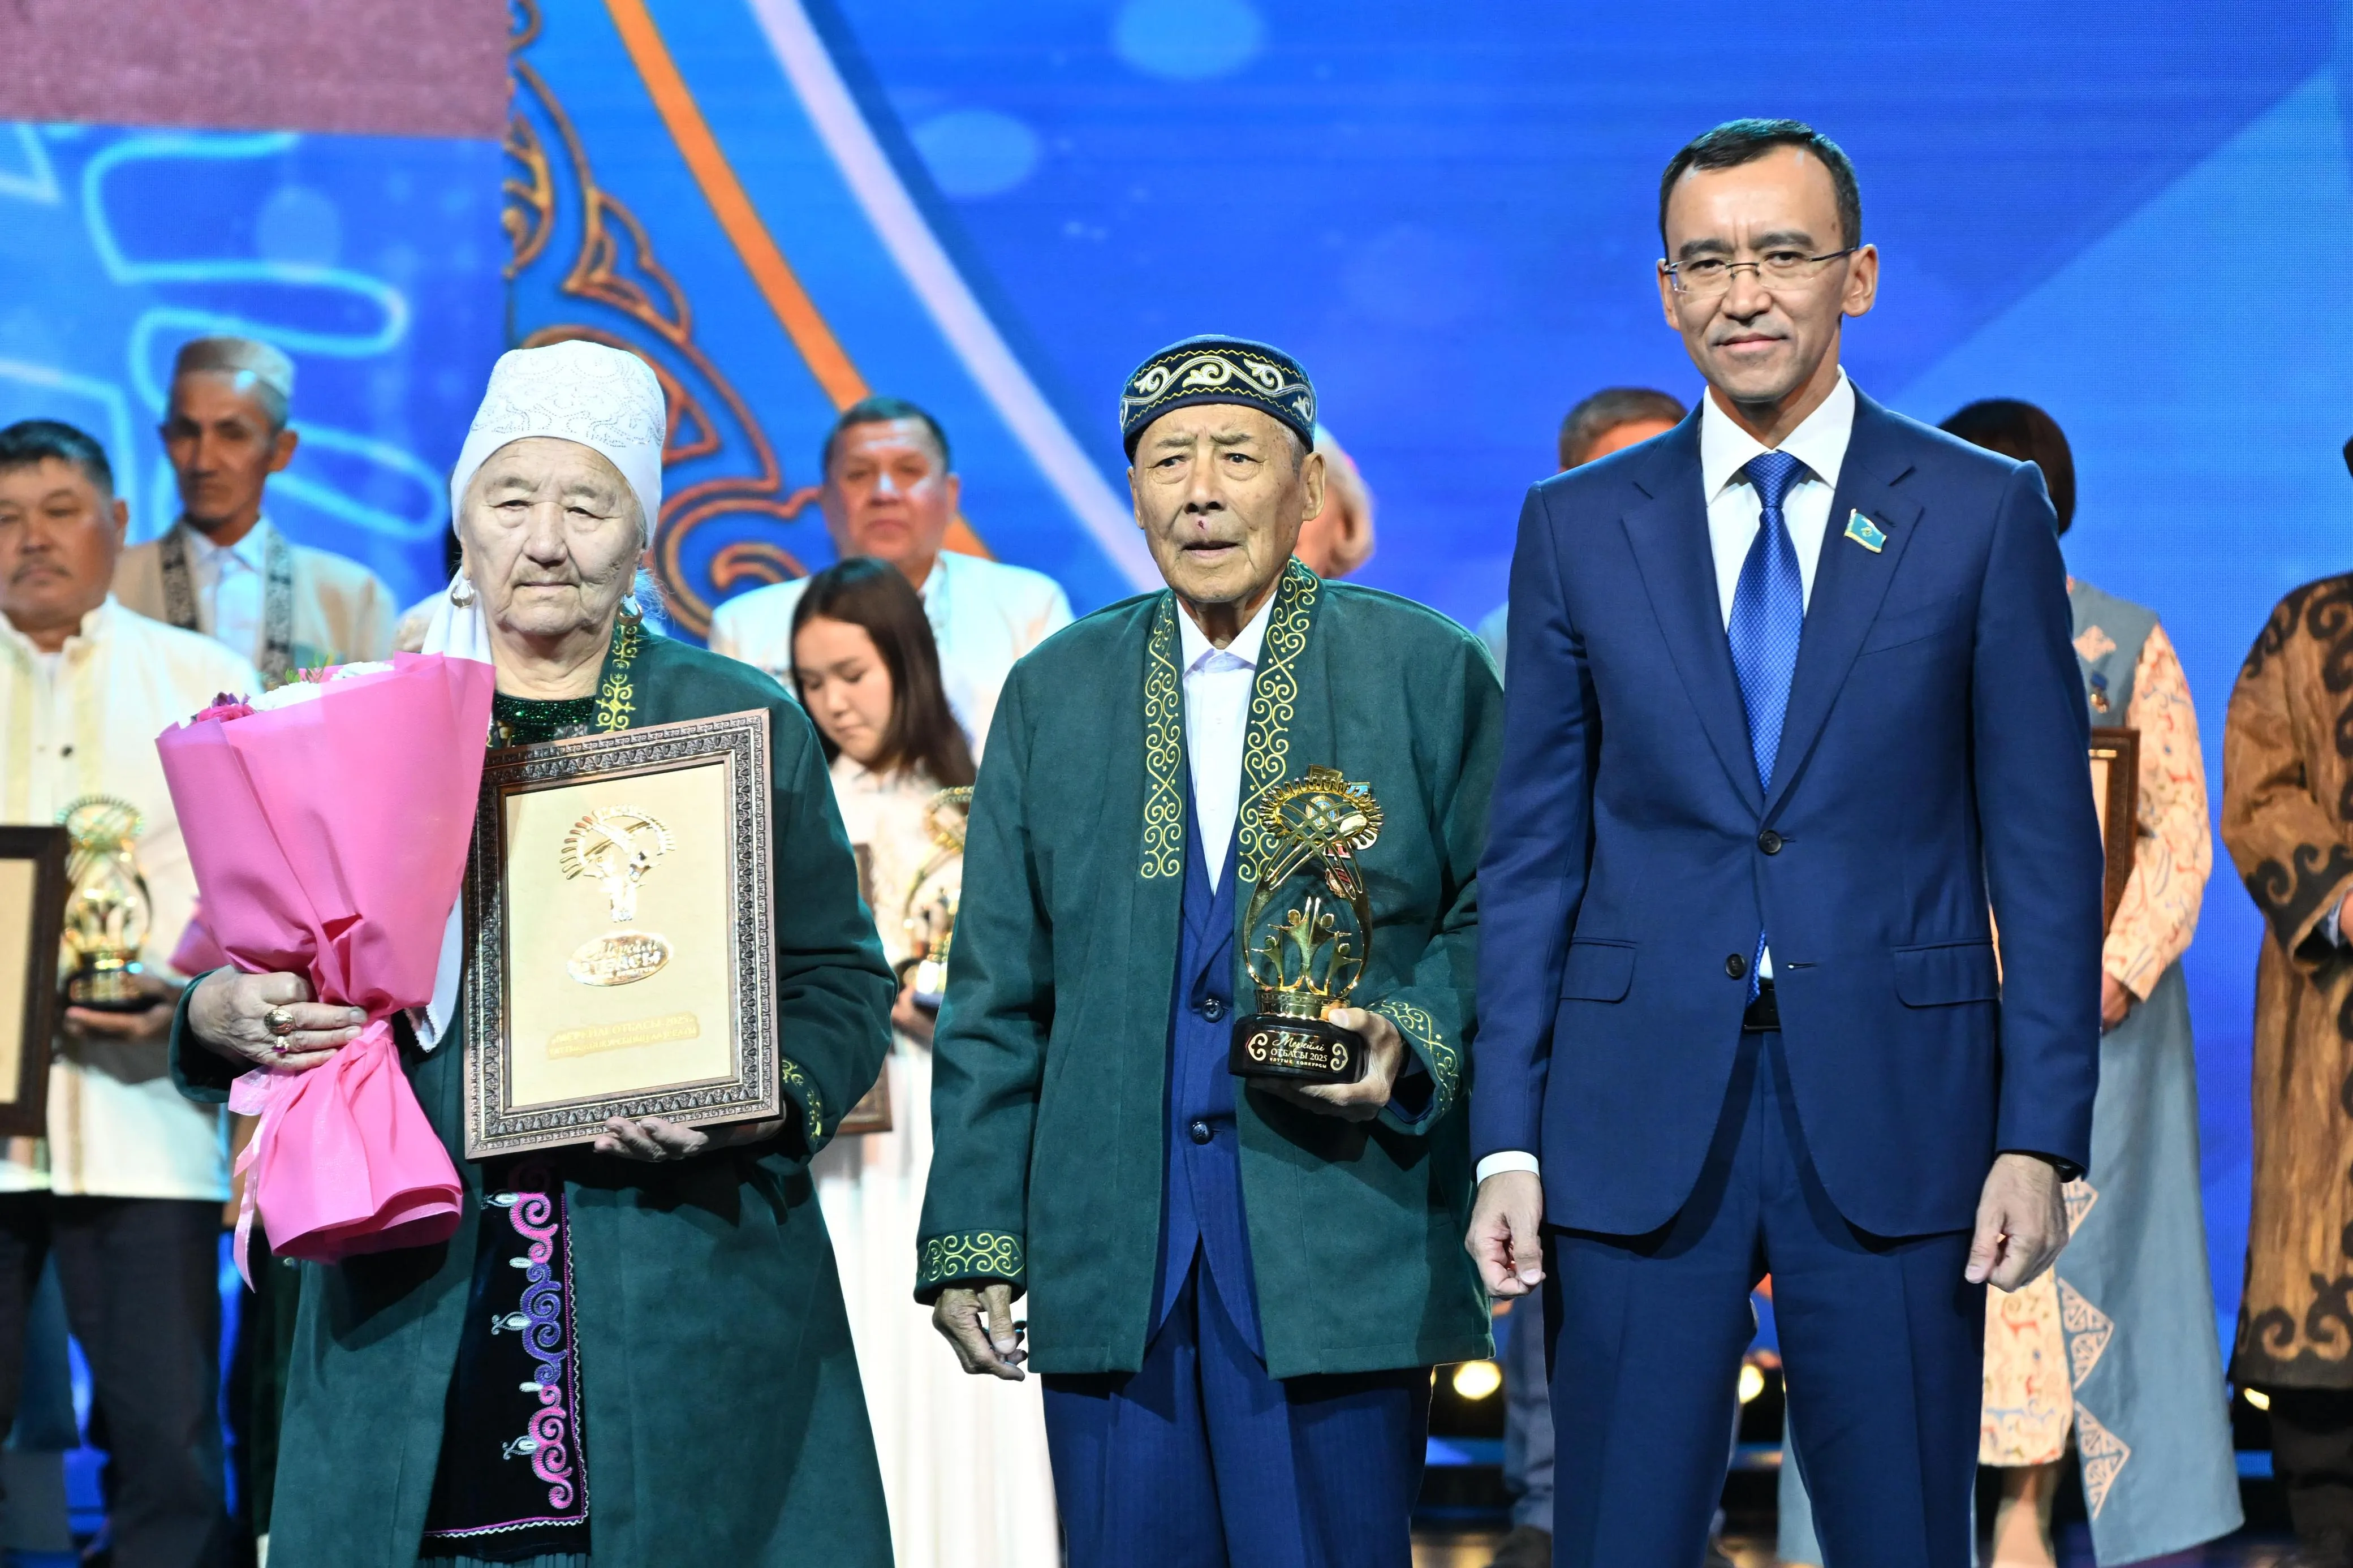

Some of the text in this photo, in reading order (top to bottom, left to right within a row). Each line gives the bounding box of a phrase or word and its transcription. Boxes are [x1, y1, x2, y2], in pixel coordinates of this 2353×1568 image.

[1272, 1035, 1325, 1052] Мерейлі
[1270, 1048, 1328, 1062] ОТБАСЫ 2025
[1296, 1060, 1327, 1069] КОНКУРСЫ
